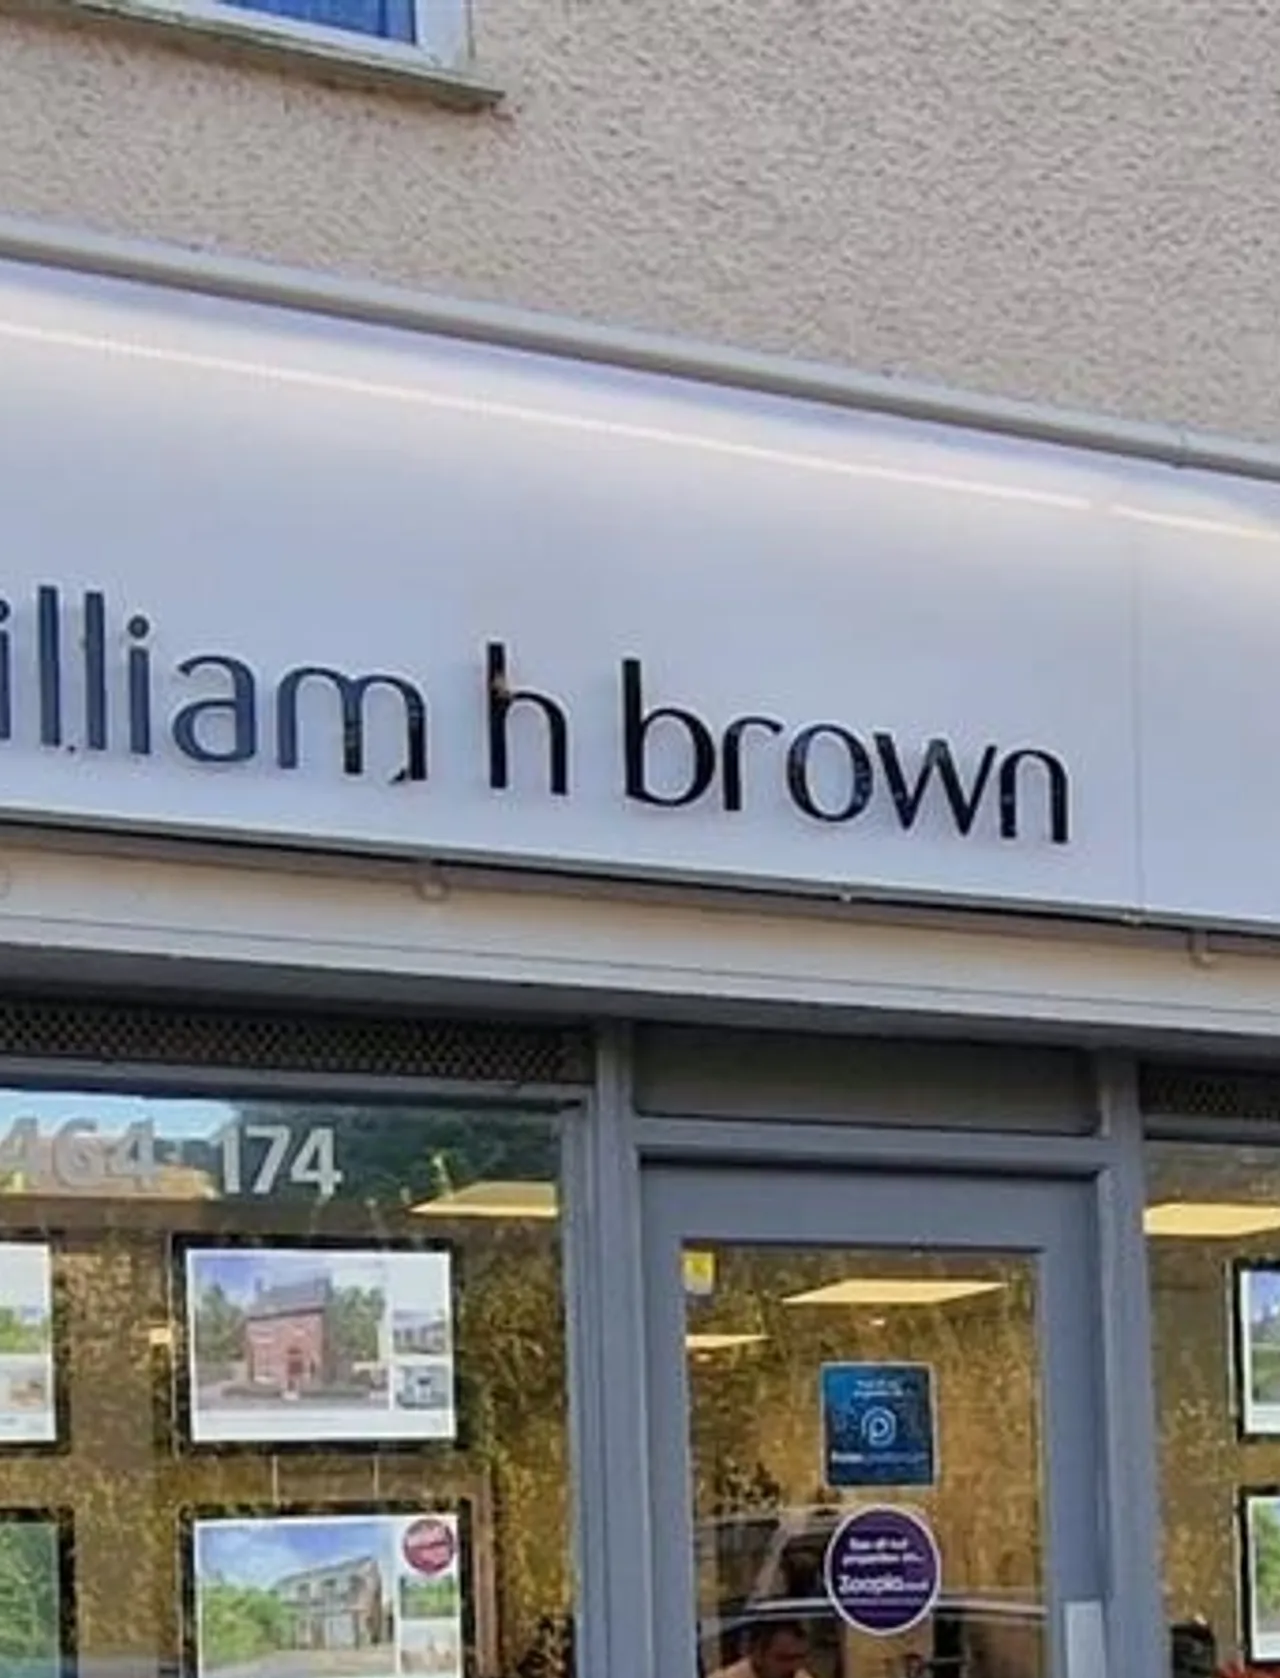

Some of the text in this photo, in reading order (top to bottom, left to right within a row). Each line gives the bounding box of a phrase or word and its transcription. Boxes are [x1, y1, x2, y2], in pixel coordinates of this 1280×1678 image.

[486, 641, 570, 796] h
[621, 657, 1072, 845] brown
[221, 1125, 343, 1198] 174
